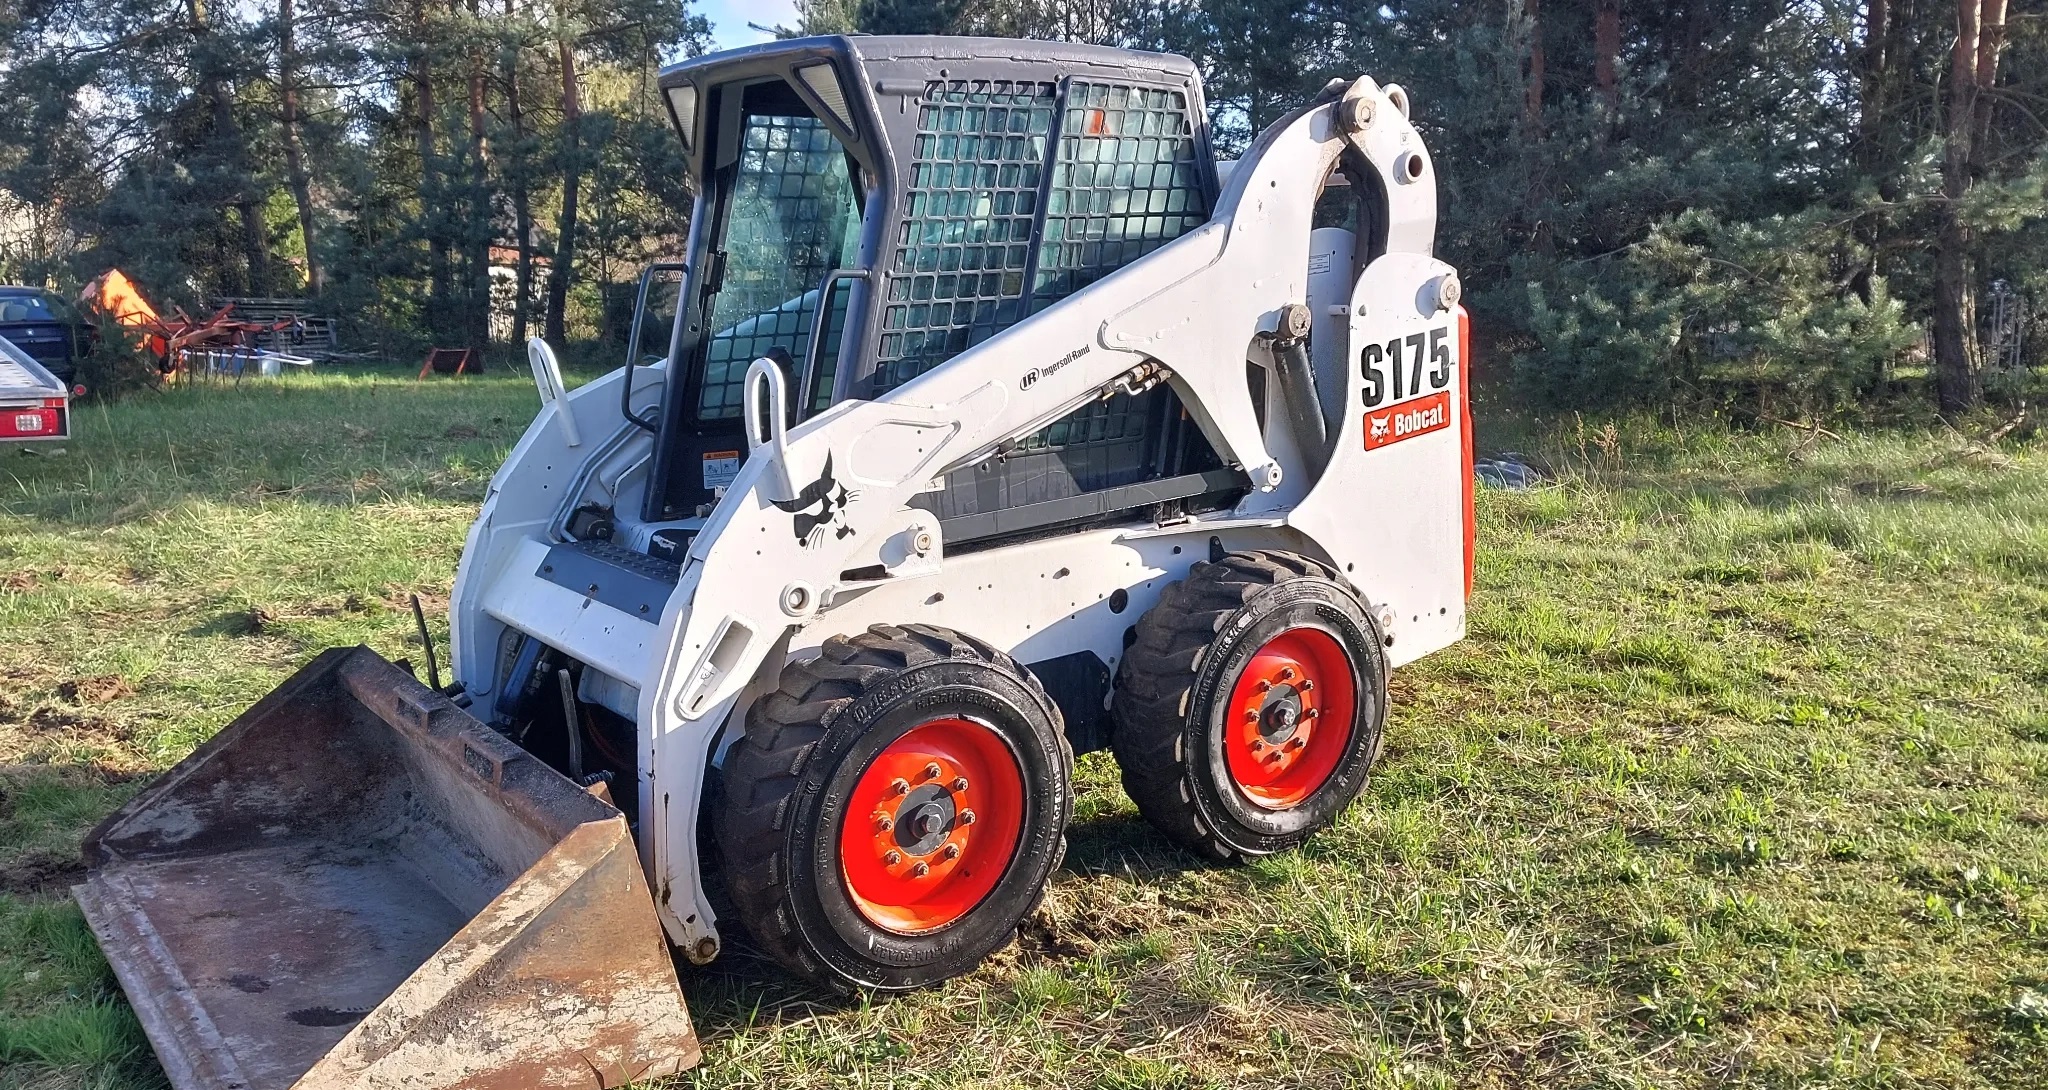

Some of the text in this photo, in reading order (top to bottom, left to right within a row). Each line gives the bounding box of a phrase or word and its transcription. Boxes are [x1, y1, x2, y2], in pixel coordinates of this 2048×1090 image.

[1021, 371, 1038, 389] IR
[1361, 326, 1449, 407] S175
[1394, 403, 1445, 437] Bobcat
